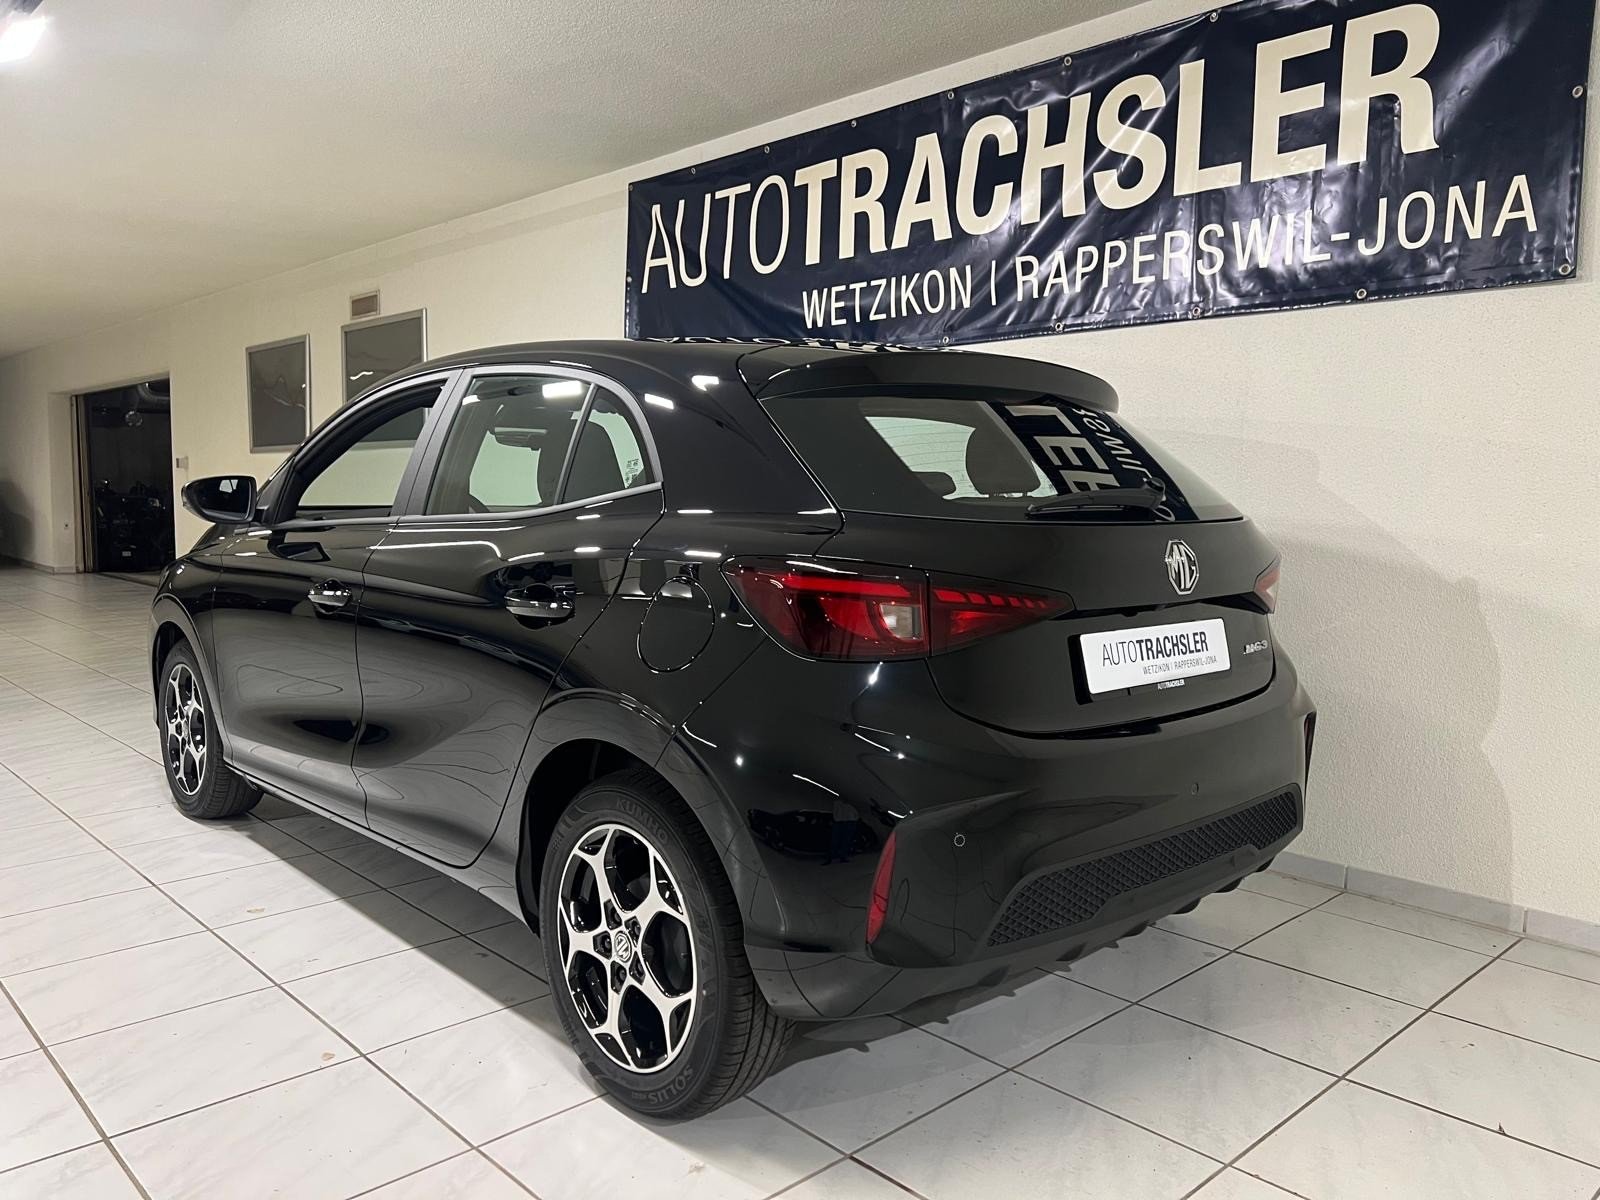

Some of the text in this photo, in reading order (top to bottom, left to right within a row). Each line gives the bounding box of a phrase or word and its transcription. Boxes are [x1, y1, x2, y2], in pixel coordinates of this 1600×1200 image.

[640, 3, 1441, 294] AUTOTRACHSLER
[802, 269, 973, 328] WETZIKON
[1015, 173, 1538, 302] RAPPERSWIL-JONA
[1165, 541, 1199, 594] MG
[1102, 631, 1209, 667] AUTOTRACHSLER
[1142, 663, 1170, 675] WETZIKON
[1174, 656, 1218, 670] RAPPERSWIL-JONA
[616, 798, 670, 842] KUMHO
[648, 1064, 694, 1104] SOLUS
